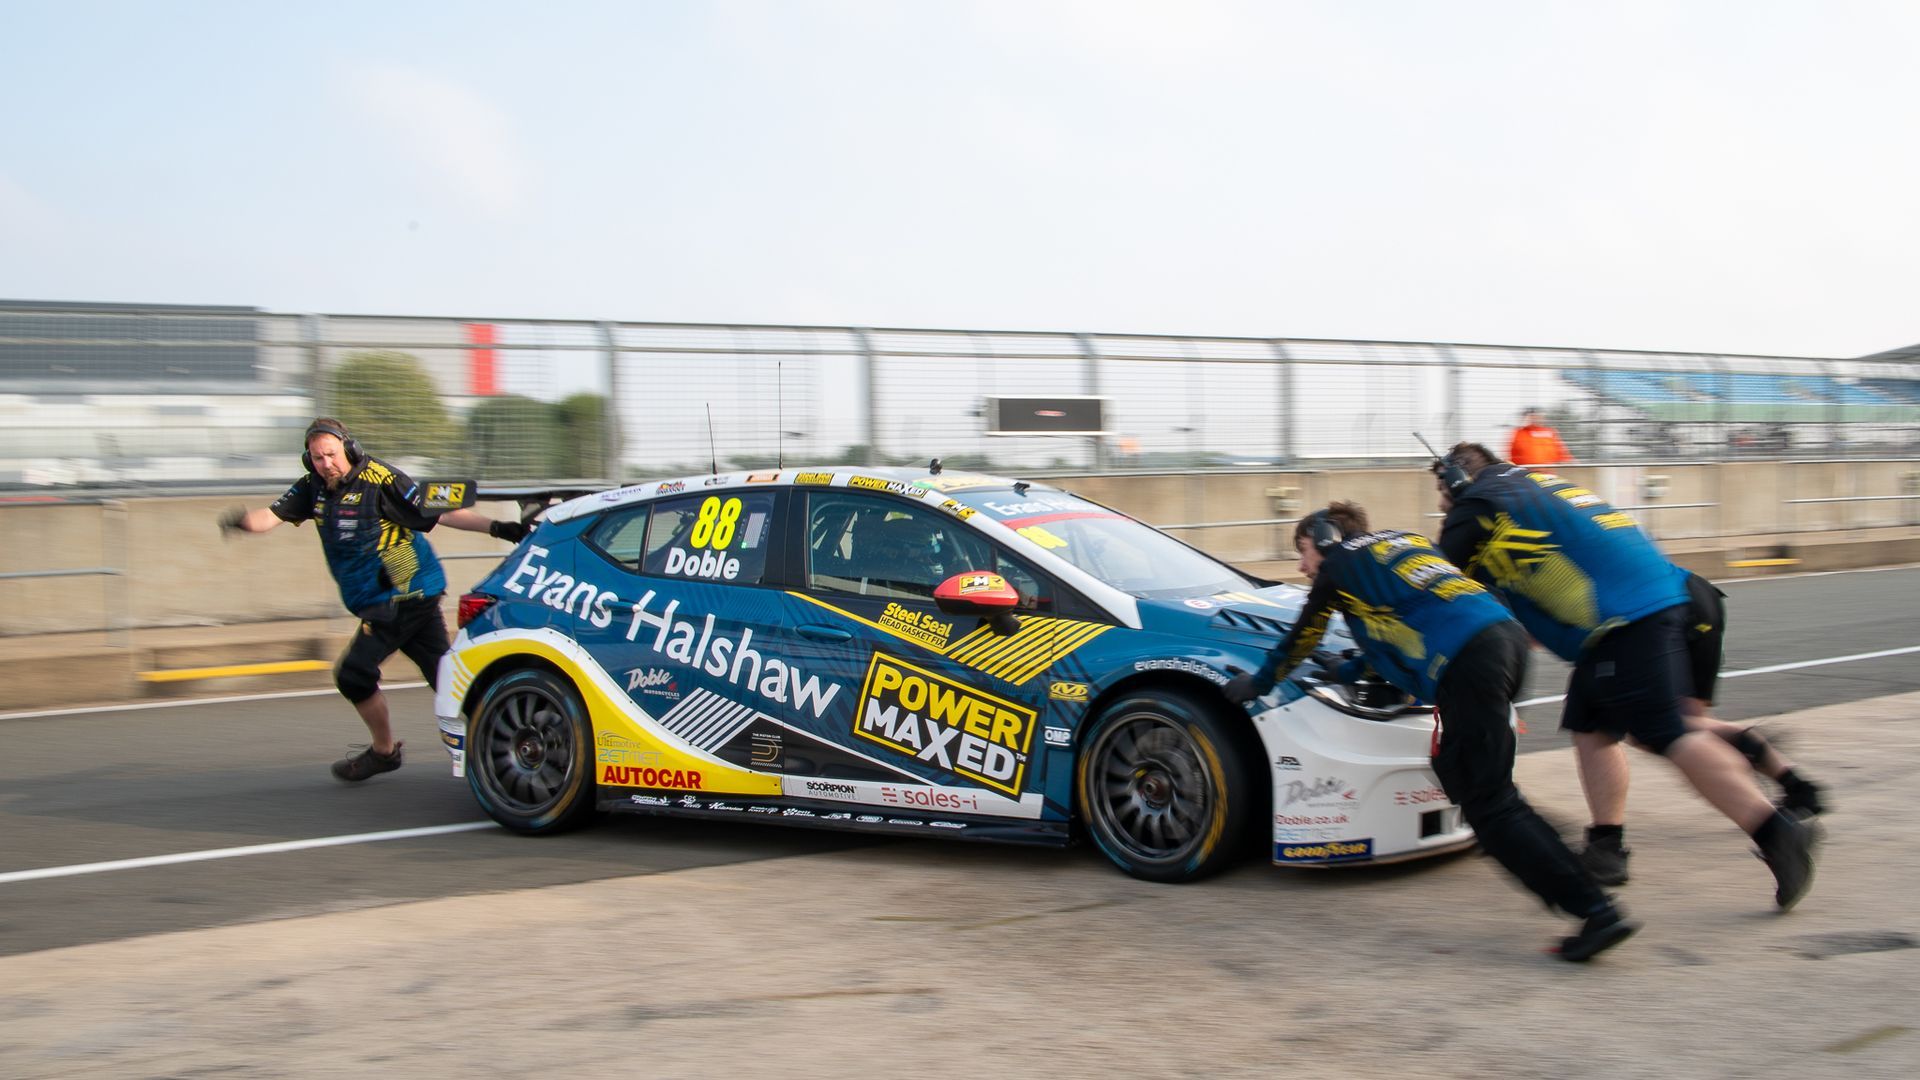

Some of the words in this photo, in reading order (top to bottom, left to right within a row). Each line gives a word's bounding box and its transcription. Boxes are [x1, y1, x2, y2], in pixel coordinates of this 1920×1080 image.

[851, 476, 888, 489] POWER
[886, 481, 924, 496] MAXED
[690, 496, 742, 550] 88
[664, 547, 740, 580] Doble
[503, 544, 619, 628] Evans
[626, 589, 841, 718] Halshaw
[880, 615, 901, 629] HEAD
[901, 623, 931, 640] GASKET
[931, 634, 946, 647] FIX
[883, 602, 922, 626] Steel
[920, 614, 953, 637] Seal
[624, 668, 673, 693] Doble
[871, 663, 1023, 750] POWER
[863, 697, 1016, 781] MAXED
[1044, 729, 1071, 742] OMP
[603, 765, 702, 789] AUTOCAR
[806, 781, 855, 794] SCORPION
[808, 790, 857, 800] AUTOMOTIVE
[904, 788, 978, 810] sales-i
